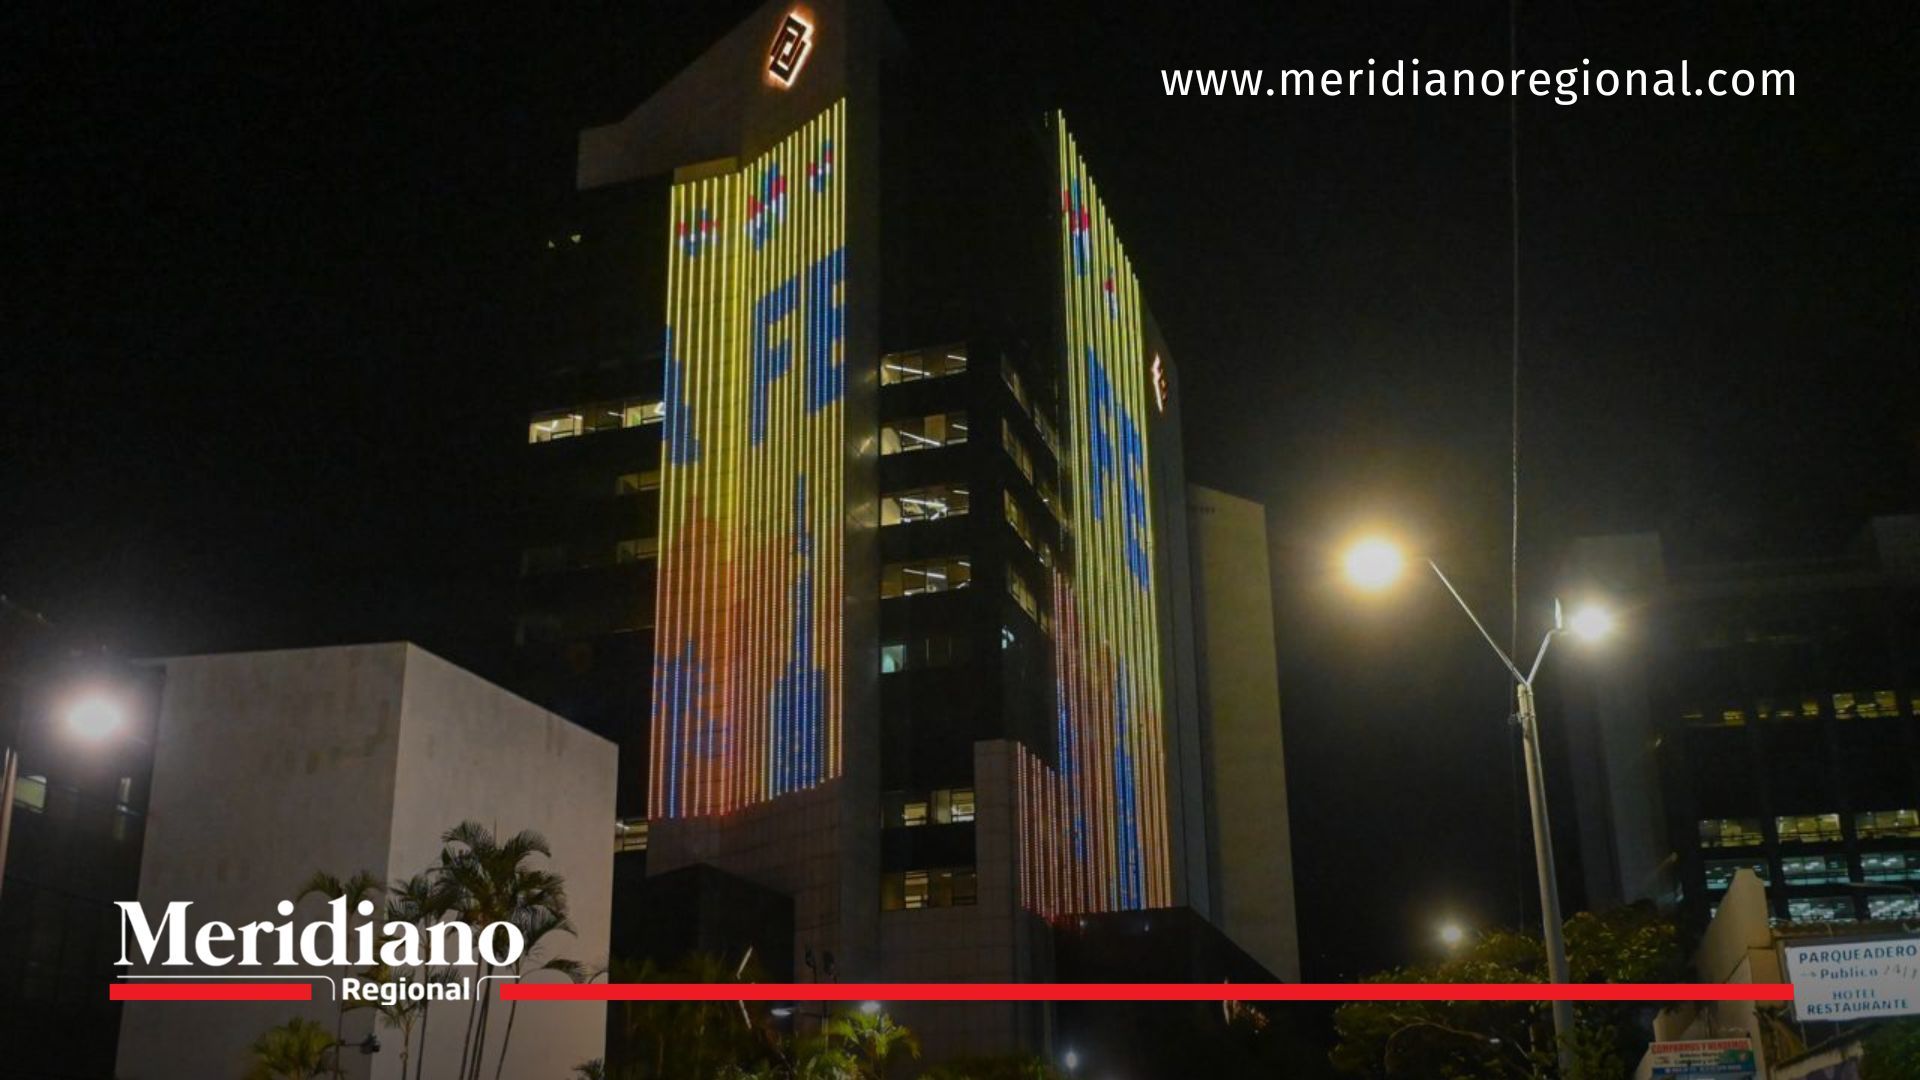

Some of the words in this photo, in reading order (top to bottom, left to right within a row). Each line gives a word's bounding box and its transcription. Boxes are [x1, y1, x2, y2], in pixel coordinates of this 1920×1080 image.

[1799, 945, 1917, 964] PARQUEADERO
[1832, 987, 1876, 1000] HOTEL
[1807, 999, 1909, 1015] RESTAURANTE
